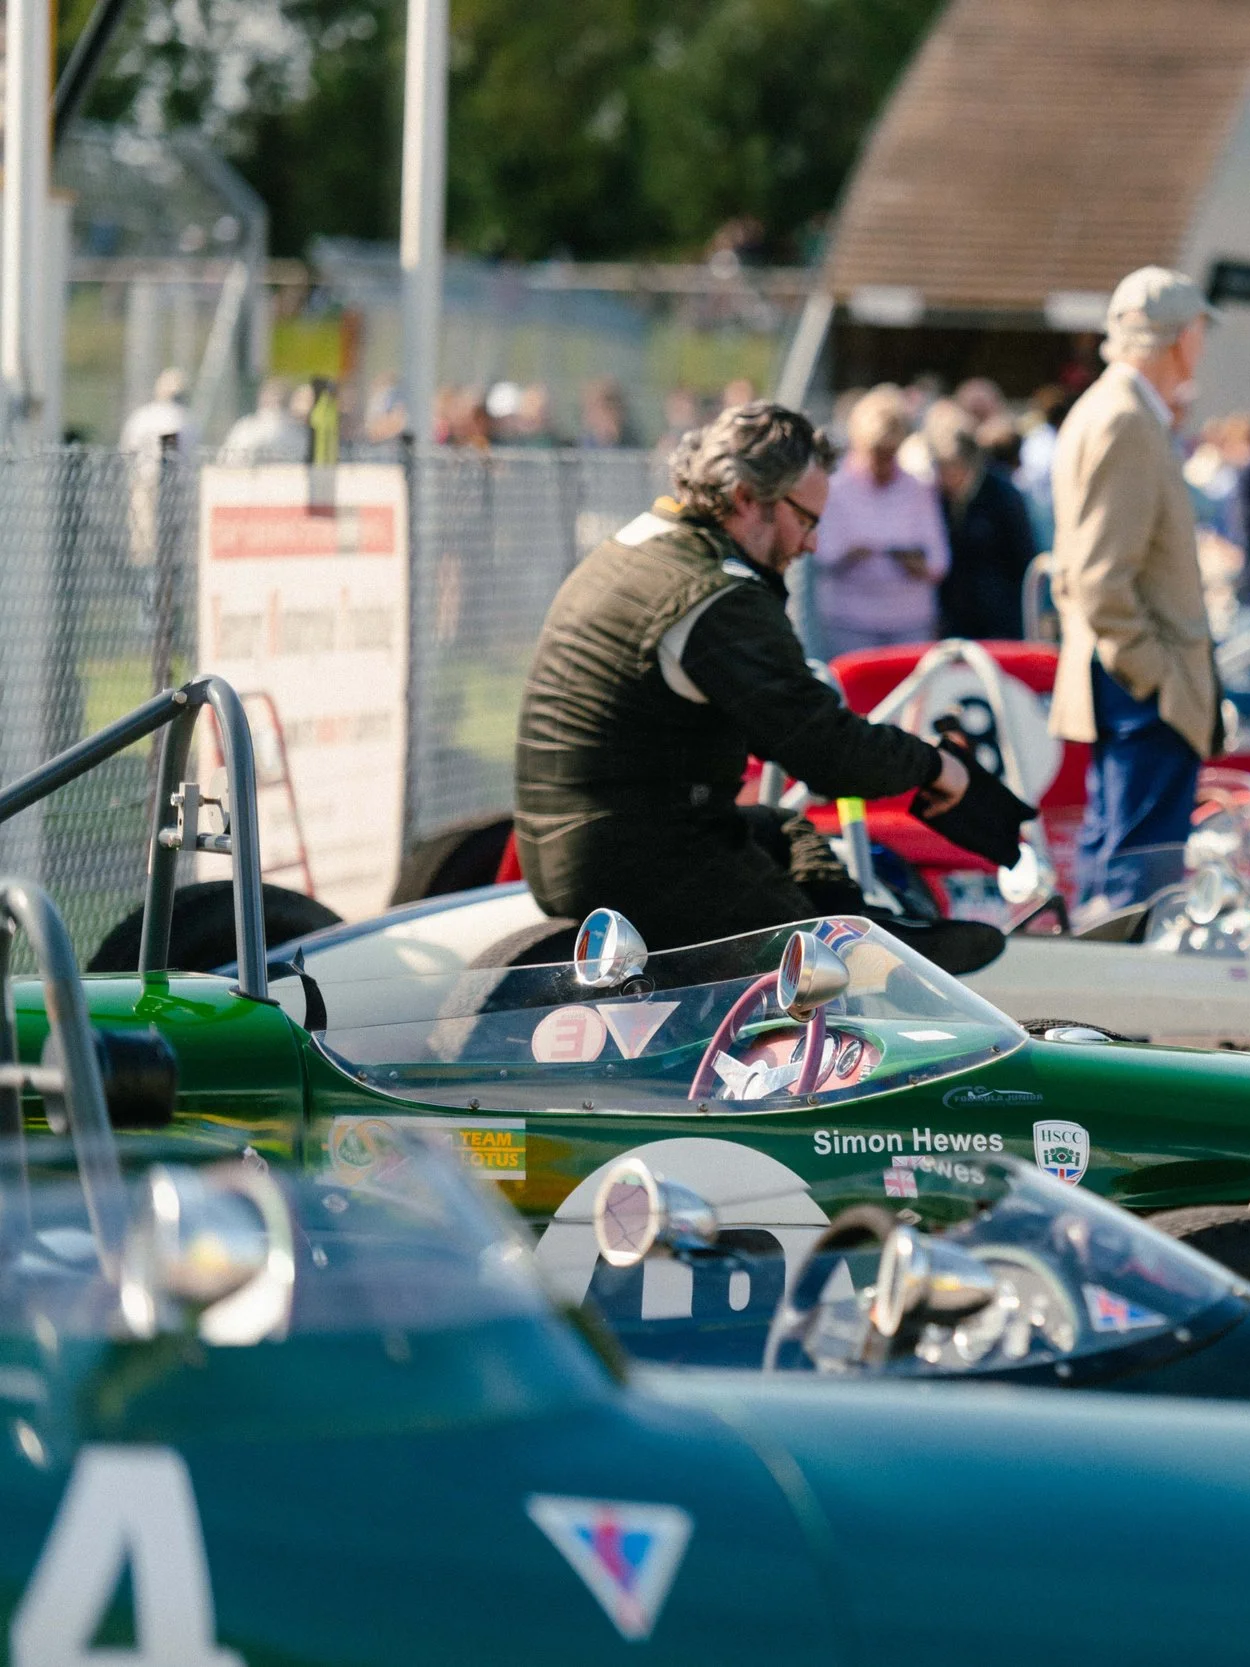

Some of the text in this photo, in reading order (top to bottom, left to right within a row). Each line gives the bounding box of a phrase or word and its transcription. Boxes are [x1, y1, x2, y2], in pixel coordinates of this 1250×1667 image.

[459, 1131, 512, 1147] TEAM
[813, 1128, 1004, 1155] Simon Hewes
[1041, 1129, 1082, 1144] HSCC
[8, 1442, 250, 1667] 4
